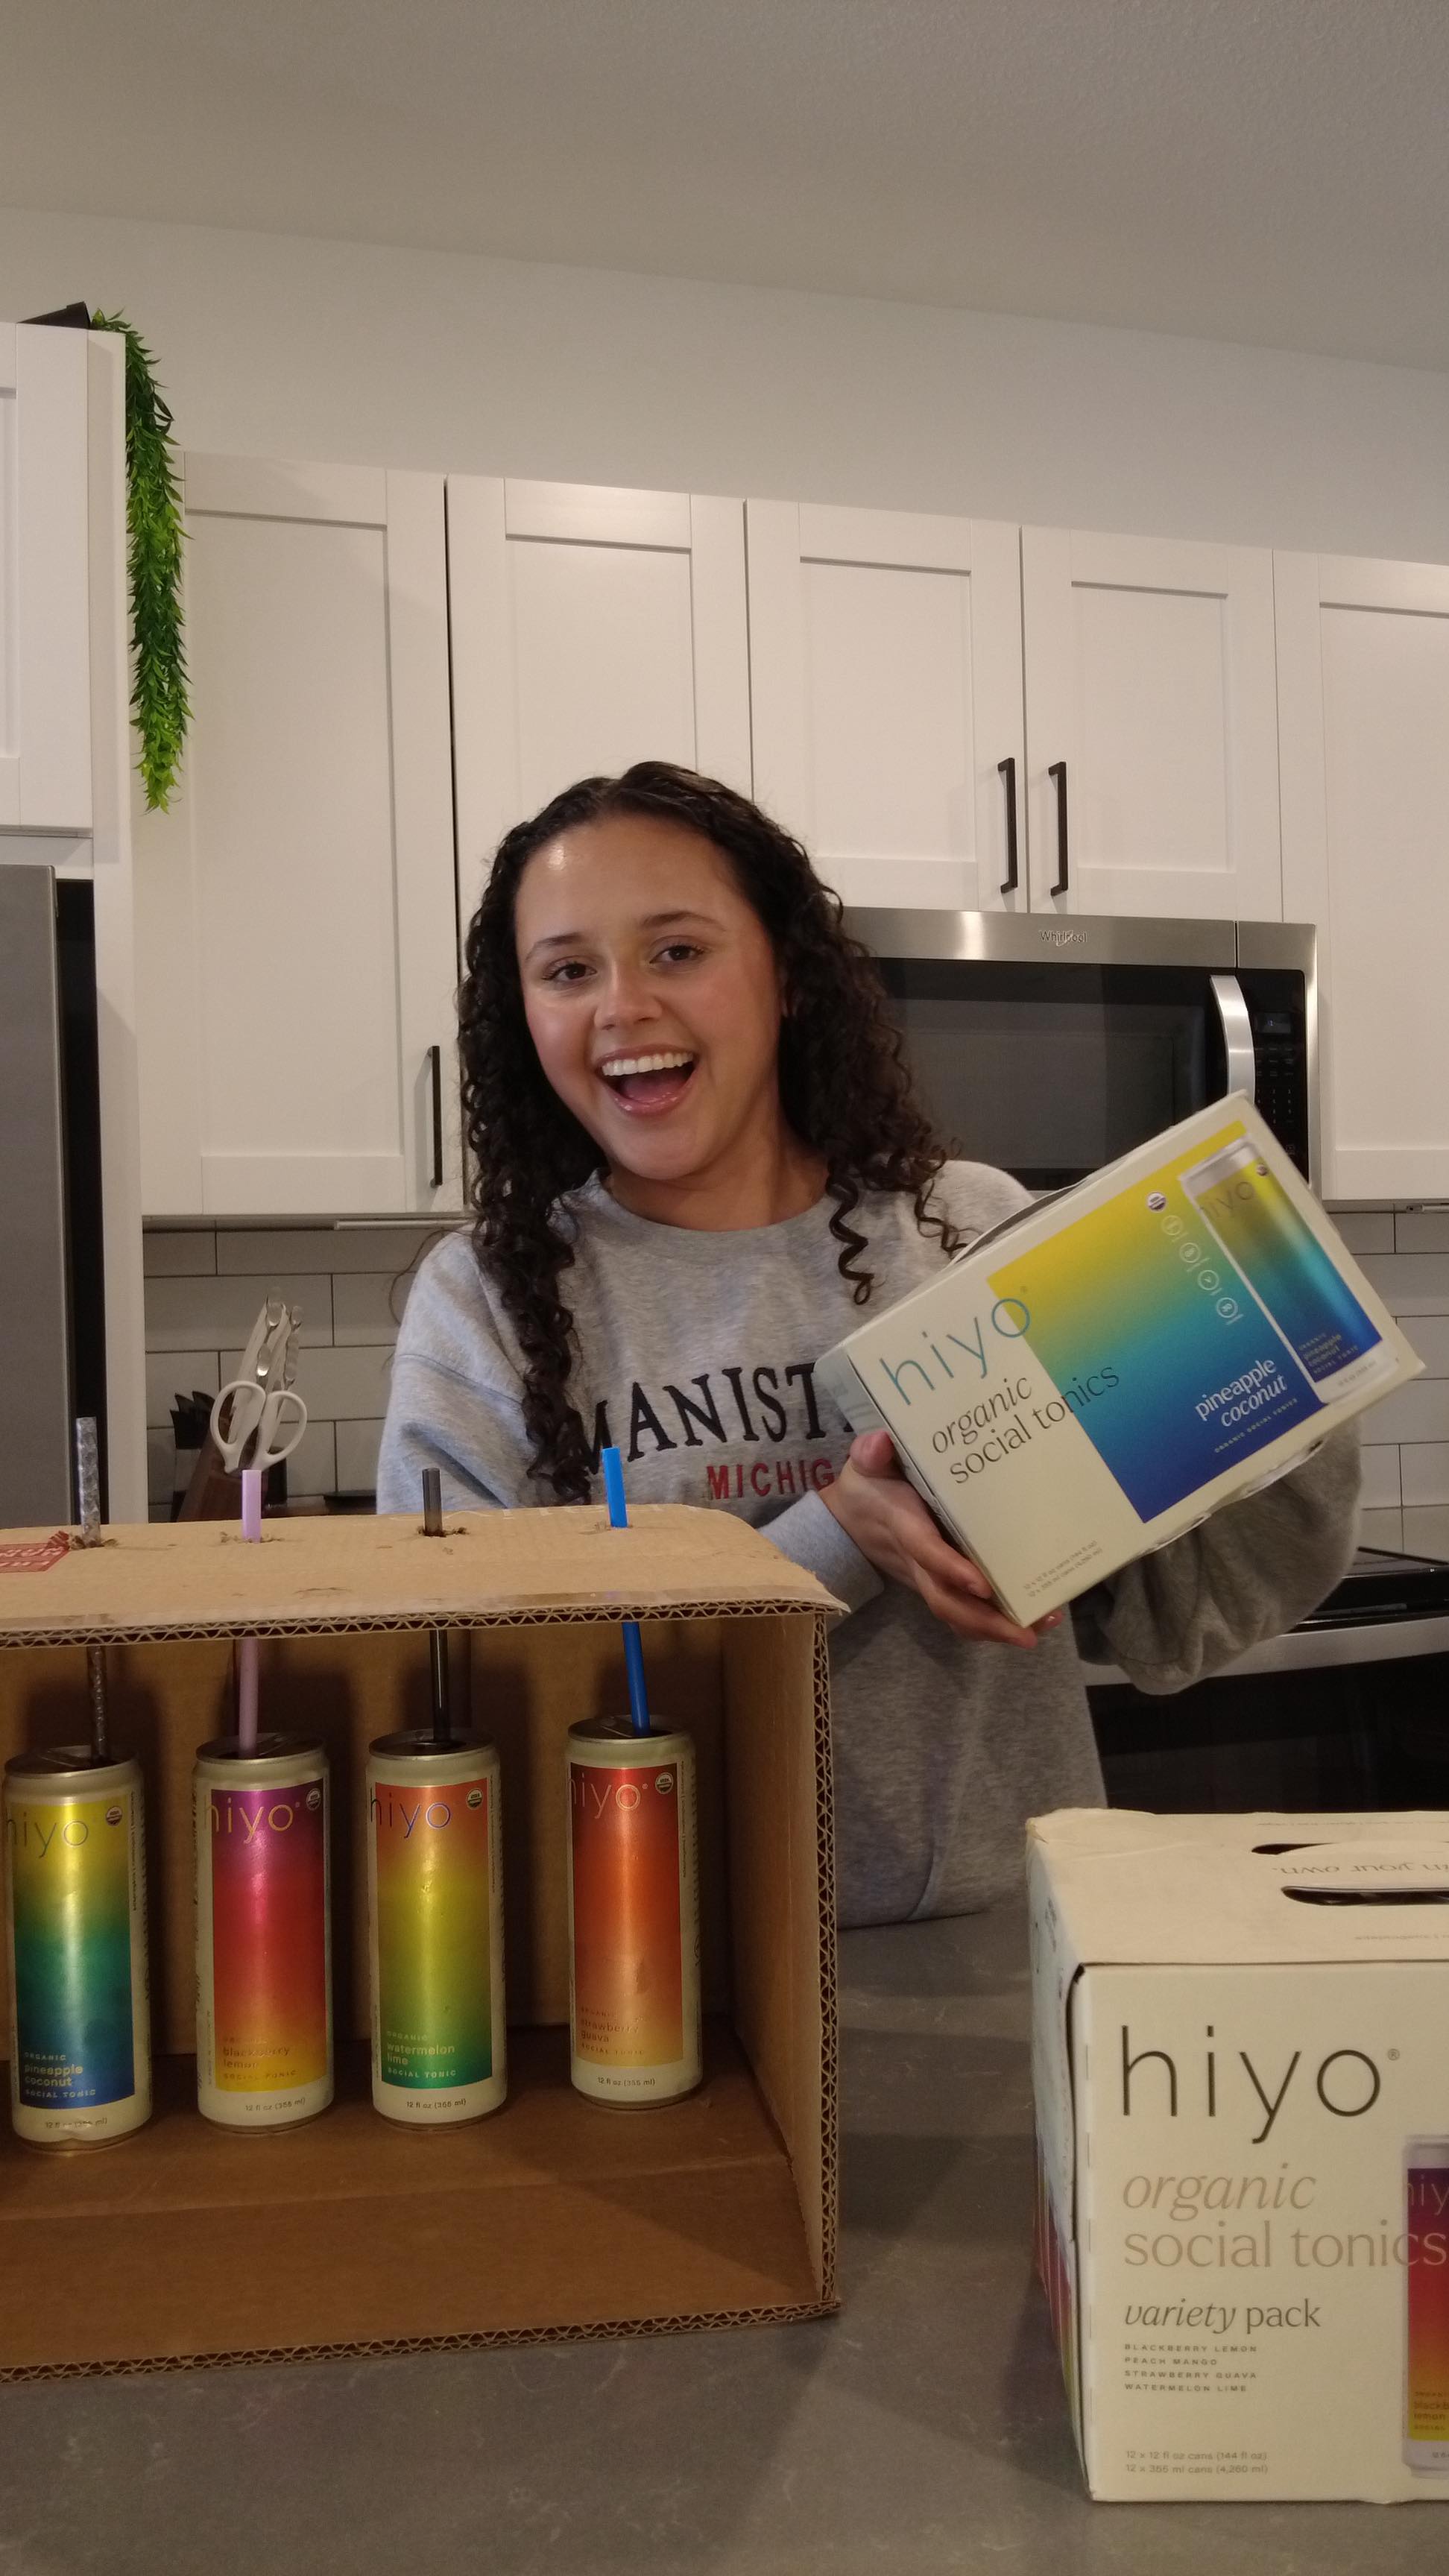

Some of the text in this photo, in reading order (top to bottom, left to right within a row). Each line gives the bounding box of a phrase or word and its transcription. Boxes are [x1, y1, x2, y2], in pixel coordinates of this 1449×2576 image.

[880, 1298, 1031, 1406] hiyo
[1194, 1359, 1278, 1421] pineapple
[1221, 1374, 1289, 1427] coconut
[932, 1377, 1033, 1453] organic
[950, 1366, 1120, 1484] social tonics
[705, 1455, 850, 1500] MICHIG
[370, 1787, 451, 1838] hiyo
[564, 1772, 641, 1819] hiyo
[203, 1795, 294, 1845] hiyo
[24, 2063, 84, 2077] pineapple
[387, 2042, 455, 2056] watermelon
[387, 2052, 409, 2065] lime
[25, 2075, 73, 2087] coconut
[1120, 2024, 1380, 2144] hiyo
[1123, 2163, 1317, 2220] organic
[1124, 2219, 1448, 2268] social tonics
[1125, 2298, 1322, 2334] variety pack
[1124, 2343, 1257, 2353] BLACKBERRY LEMON
[1124, 2357, 1167, 2365] PEACH
[1124, 2370, 1210, 2379] STRAWBERRY
[1124, 2384, 1248, 2393] WATERMELON LIME
